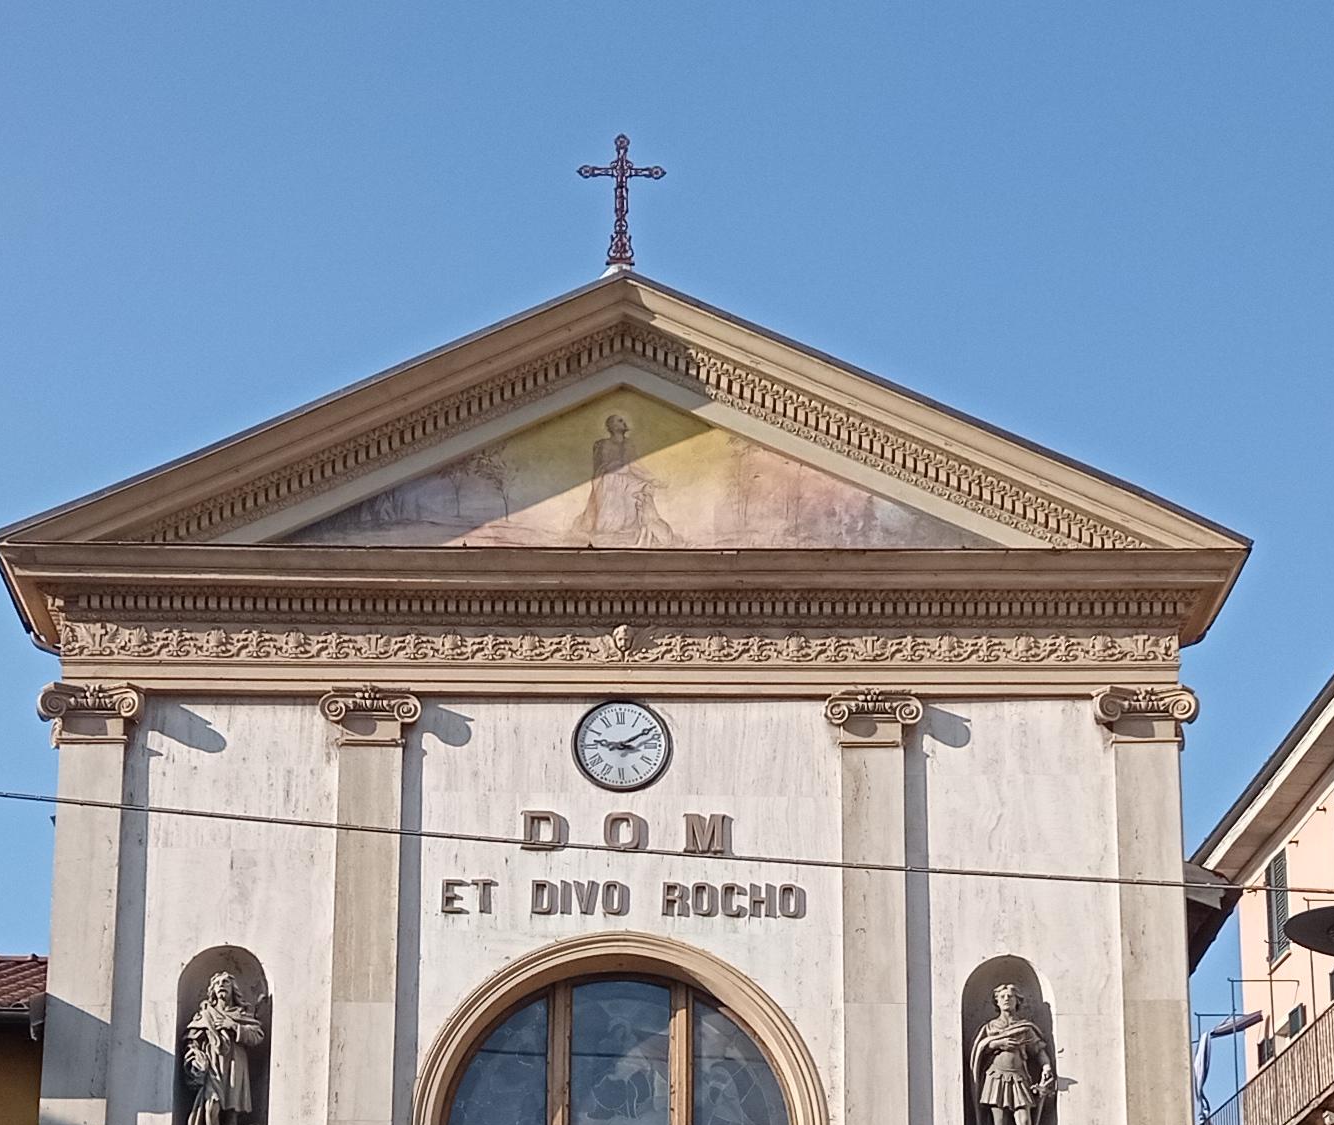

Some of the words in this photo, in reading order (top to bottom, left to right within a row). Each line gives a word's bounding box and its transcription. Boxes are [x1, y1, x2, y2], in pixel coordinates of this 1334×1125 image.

[441, 879, 498, 914] ET
[531, 880, 630, 916] DIVO
[662, 882, 806, 919] ROCHO
